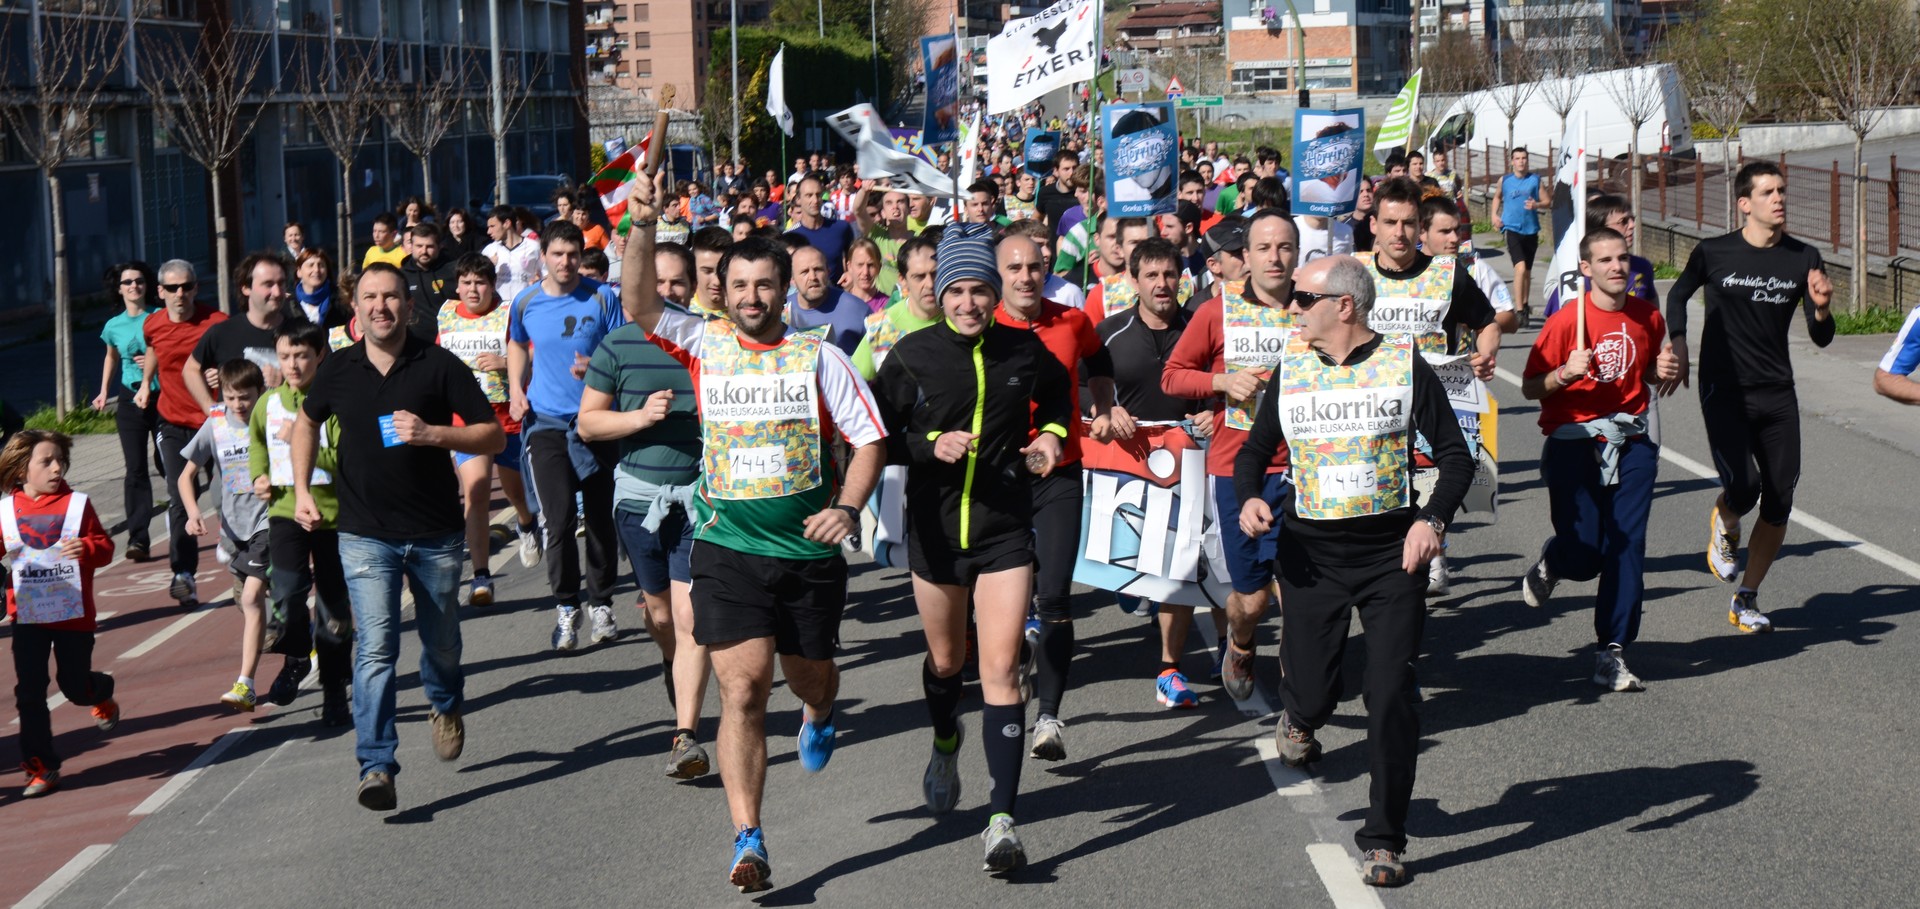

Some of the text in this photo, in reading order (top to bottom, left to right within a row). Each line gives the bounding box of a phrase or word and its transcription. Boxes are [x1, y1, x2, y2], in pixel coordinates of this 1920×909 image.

[1029, 0, 1082, 25] IHESLA
[1438, 375, 1472, 386] SKARA
[1444, 387, 1471, 399] KARRI
[730, 406, 771, 417] EUSKARA
[774, 403, 810, 416] ELKARRI
[1287, 392, 1404, 424] 18.korrika
[1292, 417, 1402, 435] EMAN EUSKARA ELKARRI
[1458, 415, 1482, 430] dik
[731, 453, 782, 475] 1445
[1322, 470, 1375, 492] 1445
